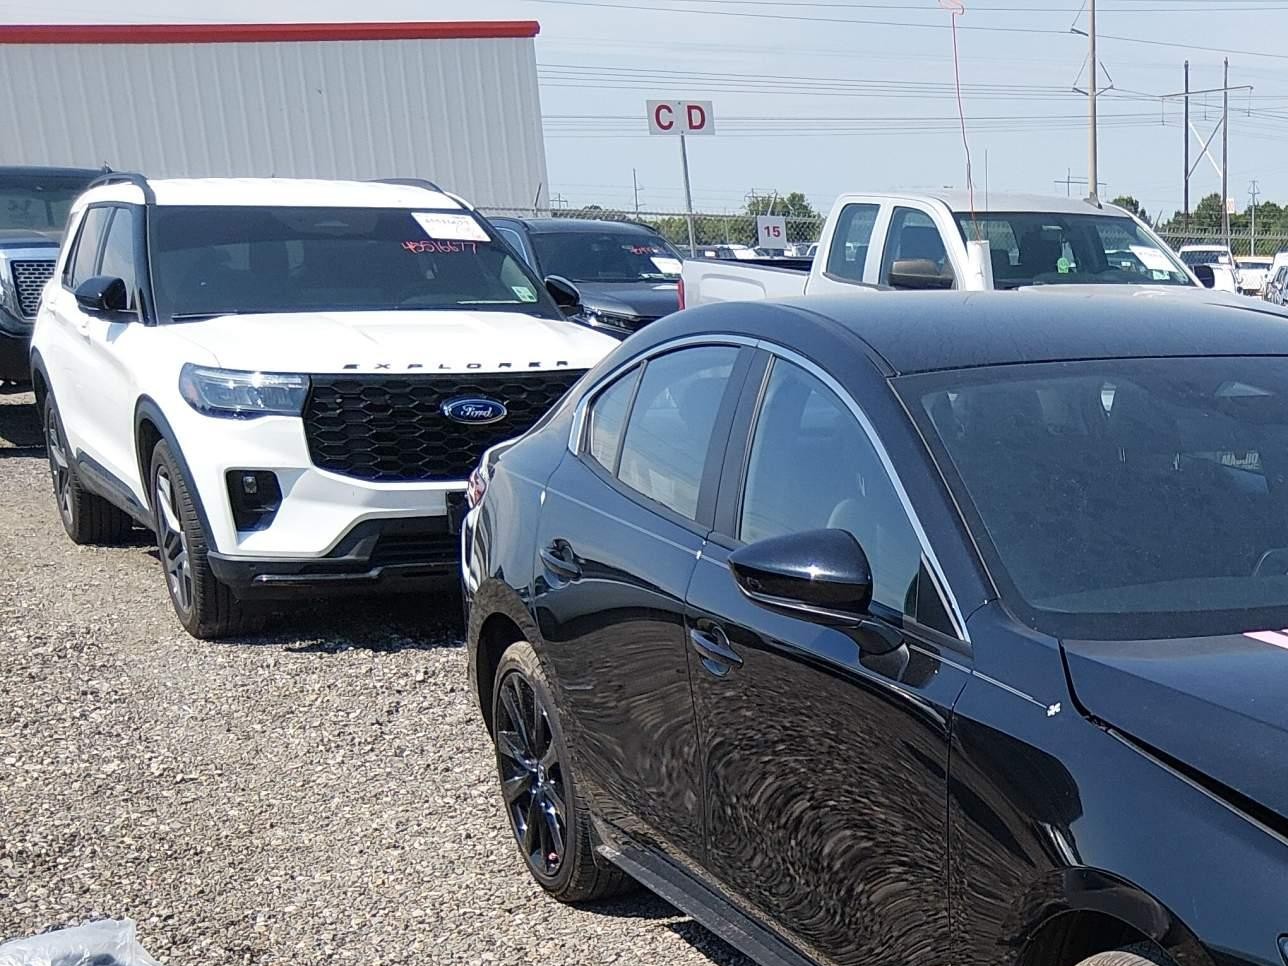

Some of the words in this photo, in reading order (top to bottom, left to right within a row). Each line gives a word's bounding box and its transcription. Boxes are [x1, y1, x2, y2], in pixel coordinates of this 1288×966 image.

[655, 104, 674, 130] C
[687, 104, 706, 130] D
[764, 225, 781, 238] 15
[342, 360, 569, 370] EXPLORER
[460, 404, 494, 420] Ford
